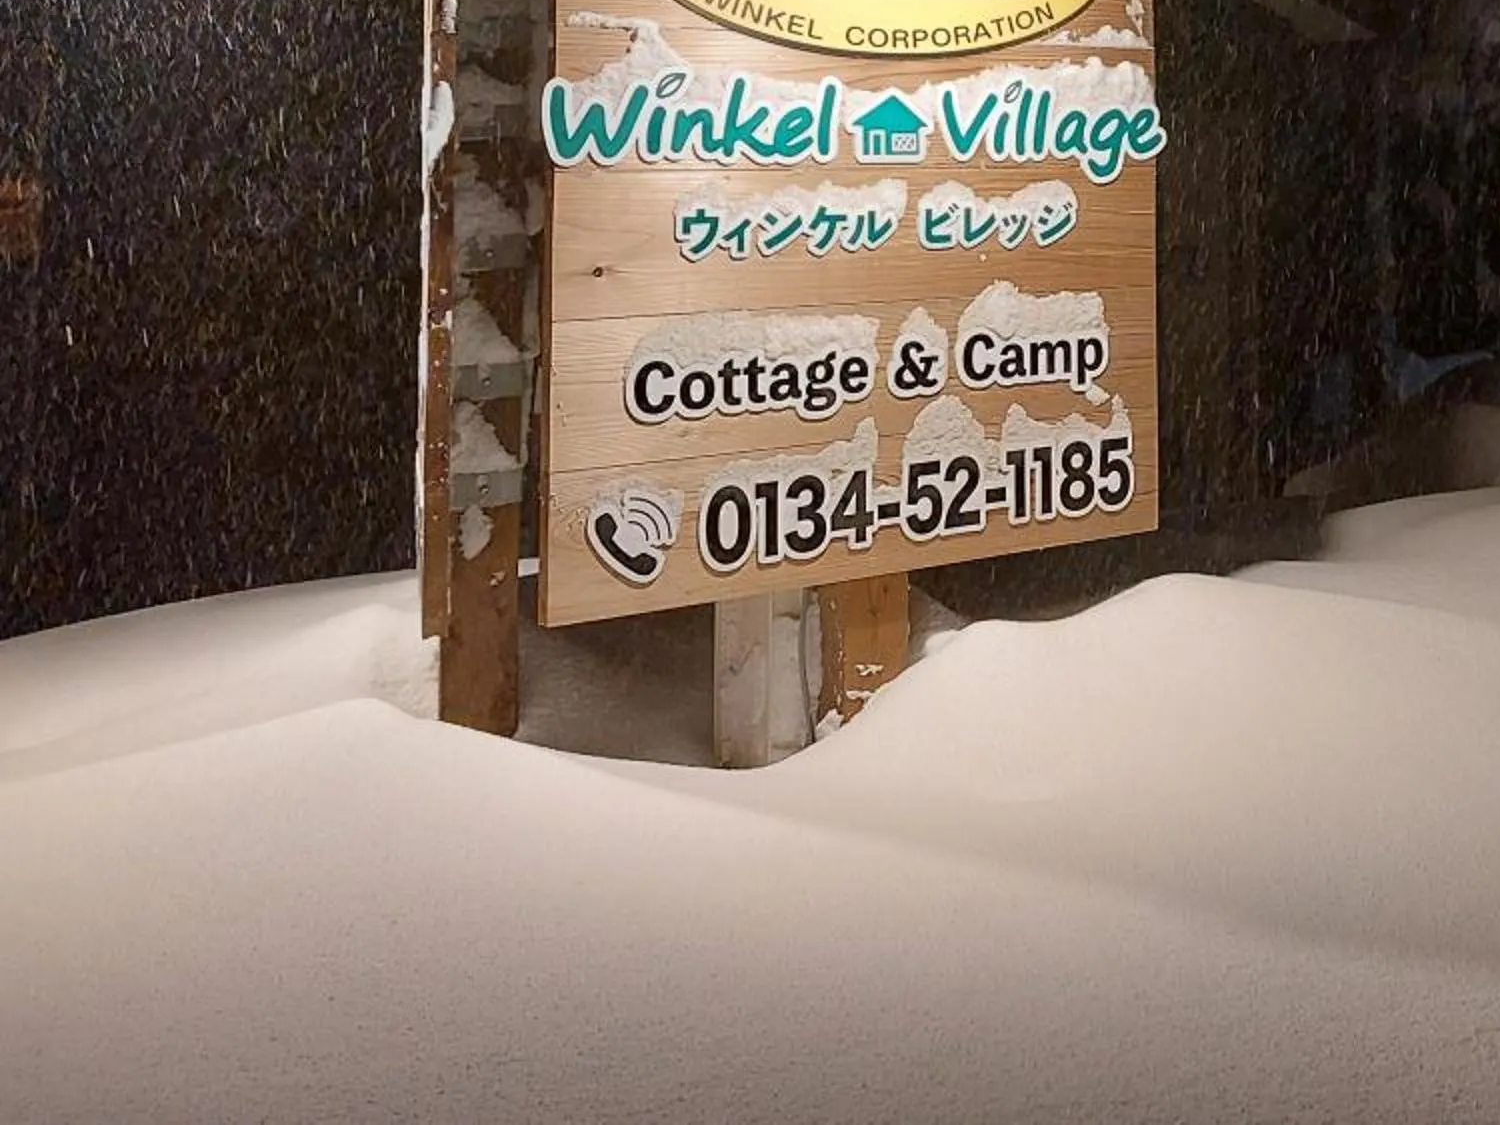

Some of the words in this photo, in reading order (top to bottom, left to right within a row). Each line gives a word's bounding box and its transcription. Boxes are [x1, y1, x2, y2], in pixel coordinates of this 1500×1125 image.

[845, 1, 1055, 50] CORPORATION
[548, 73, 839, 160] Winkel
[941, 79, 1162, 176] Village
[681, 206, 893, 255] ウィンケル
[924, 202, 1073, 246] ビレッジ
[633, 349, 870, 416] Cottage
[894, 340, 938, 391] &
[961, 331, 1102, 386] Camp
[704, 436, 1132, 566] 0134-52-1185
